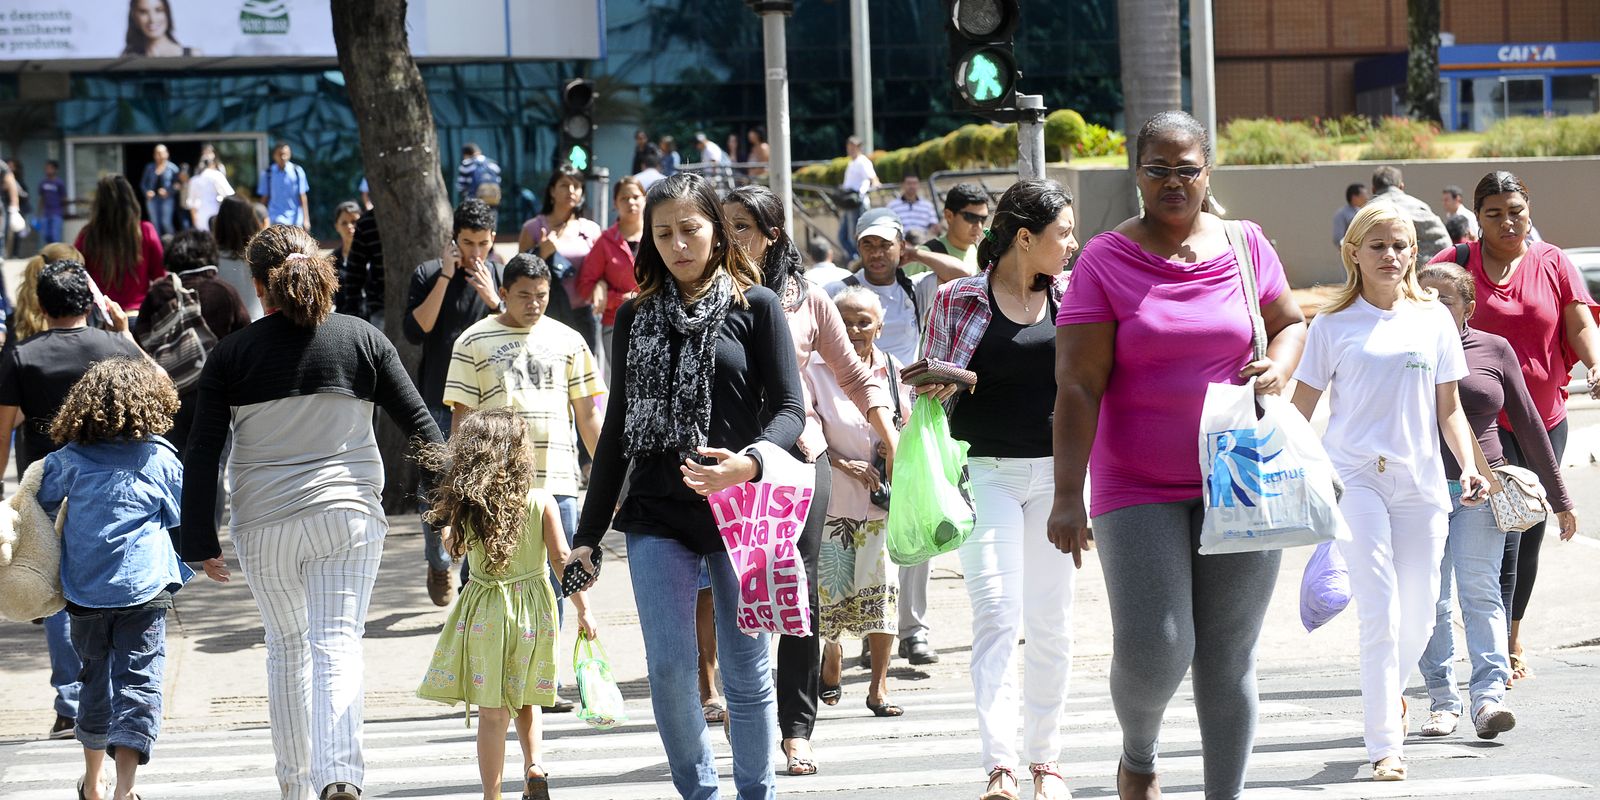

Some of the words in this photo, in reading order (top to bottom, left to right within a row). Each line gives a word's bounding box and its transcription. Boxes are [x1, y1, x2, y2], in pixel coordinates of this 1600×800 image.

[9, 9, 72, 21] desconto
[13, 25, 72, 35] milhares
[1497, 45, 1556, 62] CAIXA
[773, 520, 804, 635] marisa
